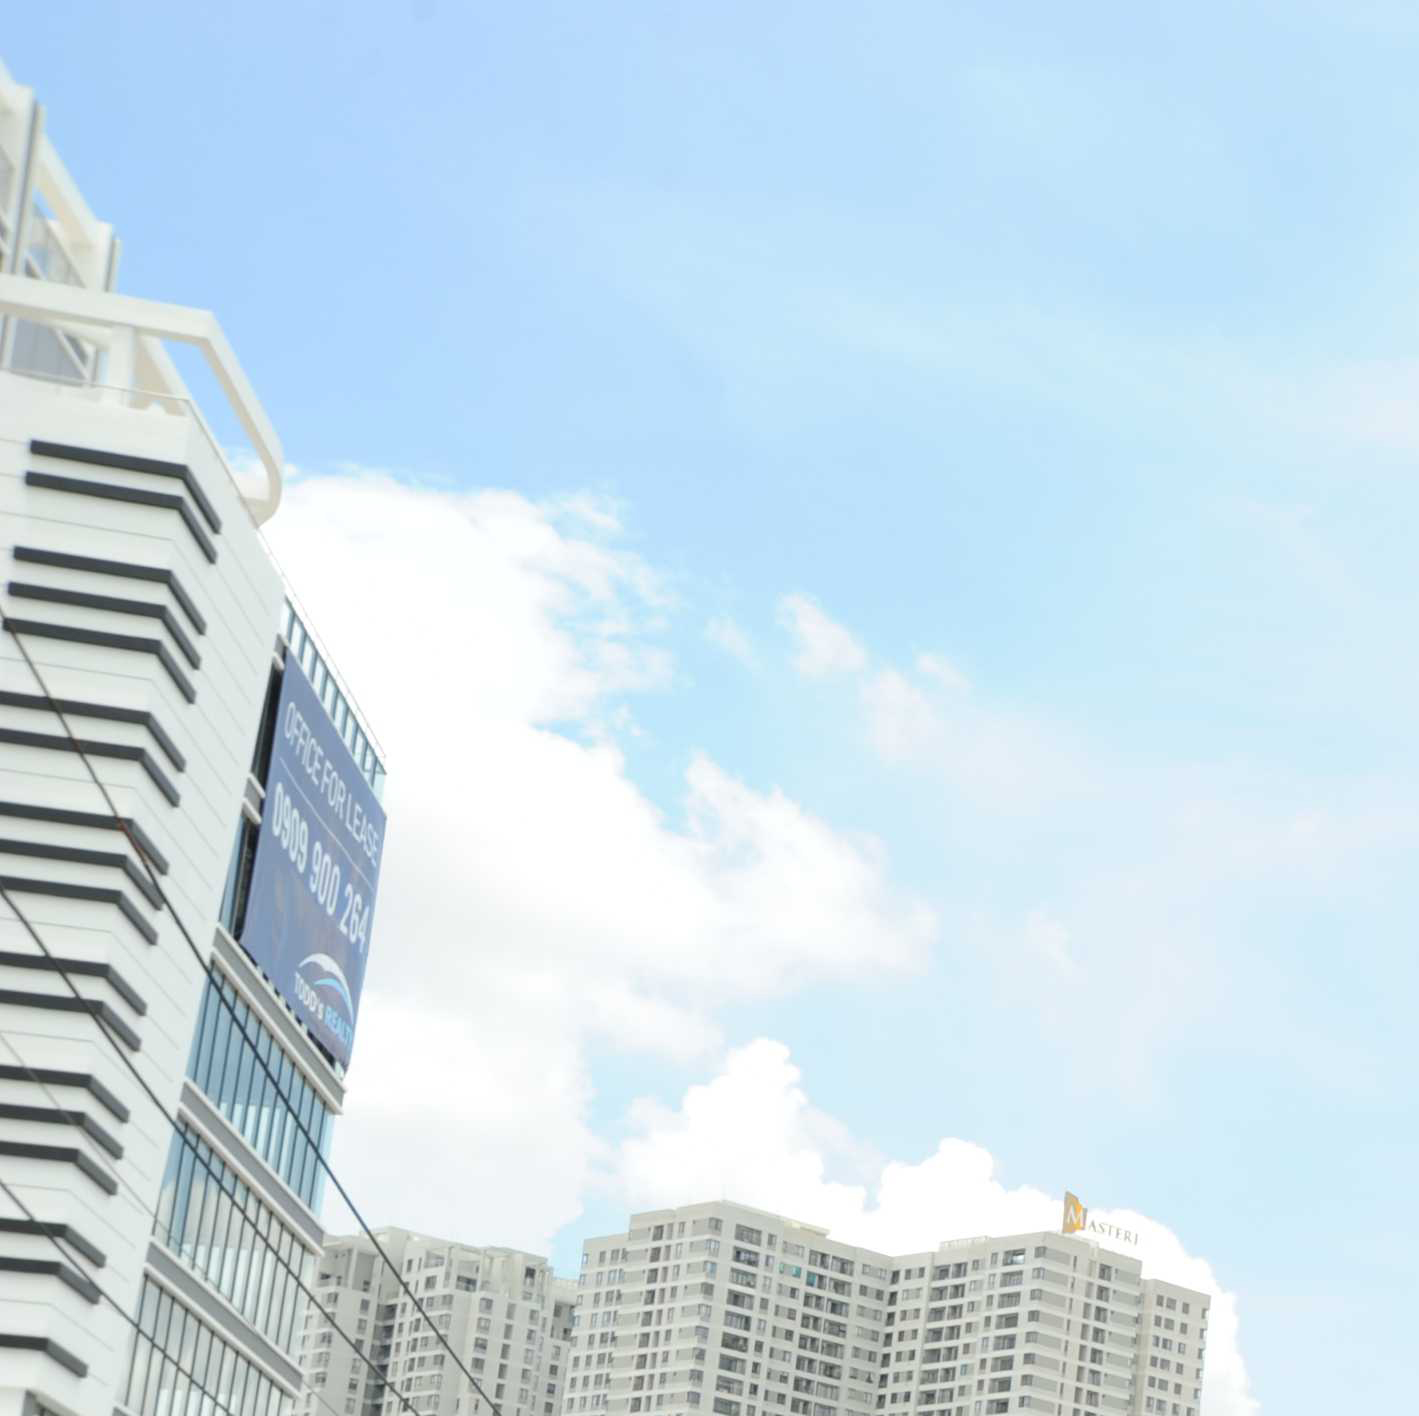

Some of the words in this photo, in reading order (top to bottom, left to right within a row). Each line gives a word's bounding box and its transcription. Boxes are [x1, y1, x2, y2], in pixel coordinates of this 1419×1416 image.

[272, 782, 309, 874] 0909
[309, 841, 341, 916] 900
[339, 882, 370, 954] 264
[284, 701, 324, 785] OFFICE
[321, 760, 346, 820] FOR
[344, 793, 379, 868] LEASE
